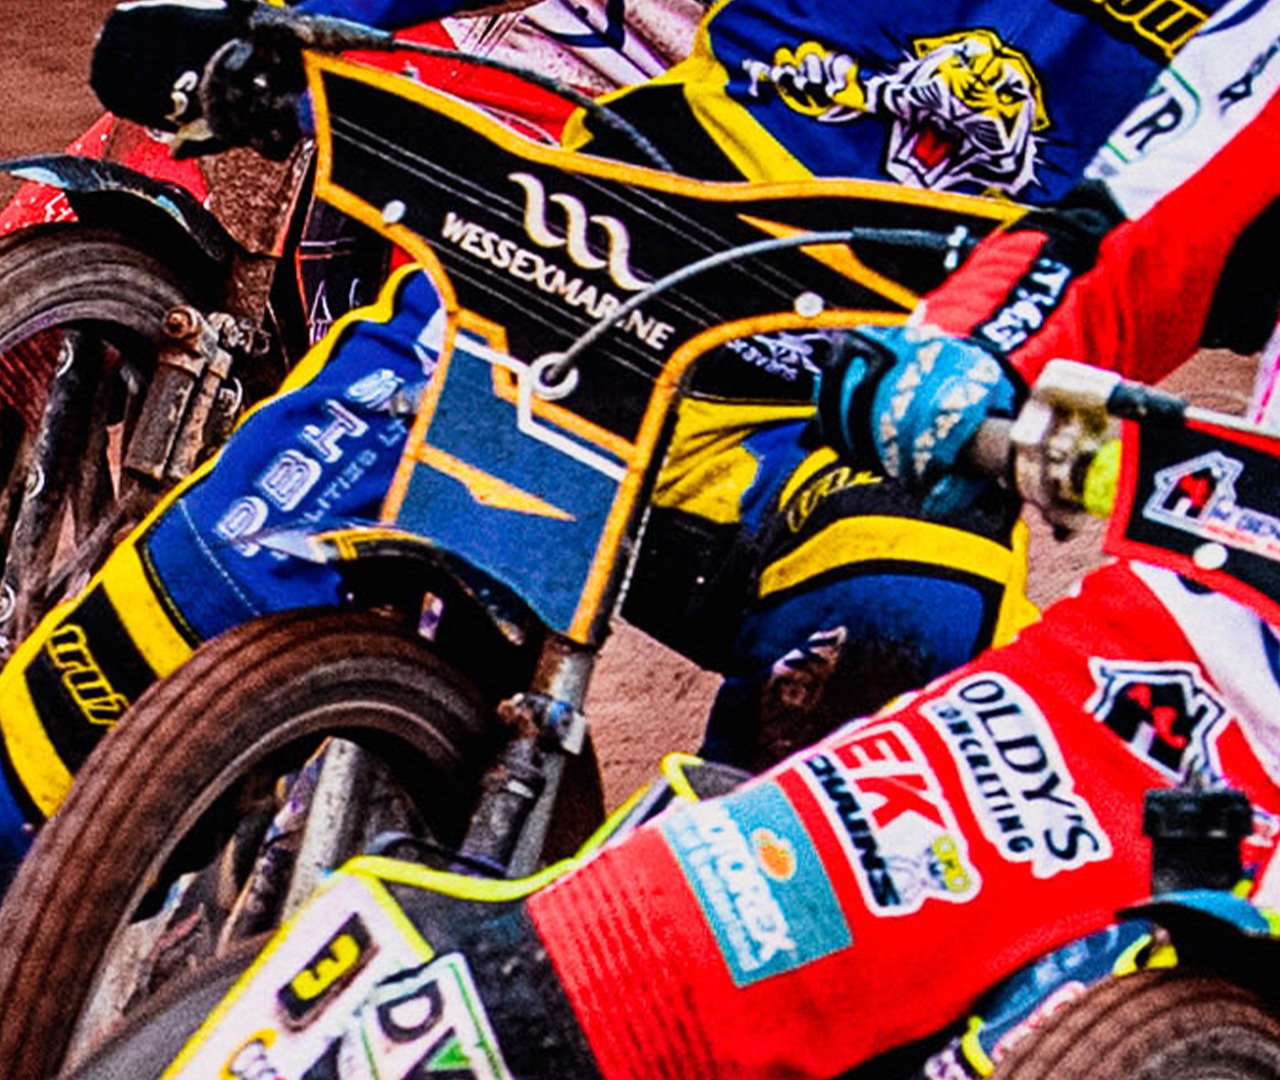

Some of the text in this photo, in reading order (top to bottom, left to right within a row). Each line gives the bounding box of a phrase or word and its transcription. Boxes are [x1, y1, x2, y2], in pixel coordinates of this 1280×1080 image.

[440, 210, 676, 351] WESSEXMARNE
[833, 729, 948, 830] EK
[934, 702, 1035, 854] ONCRETING
[957, 679, 1101, 861] OLDY'S
